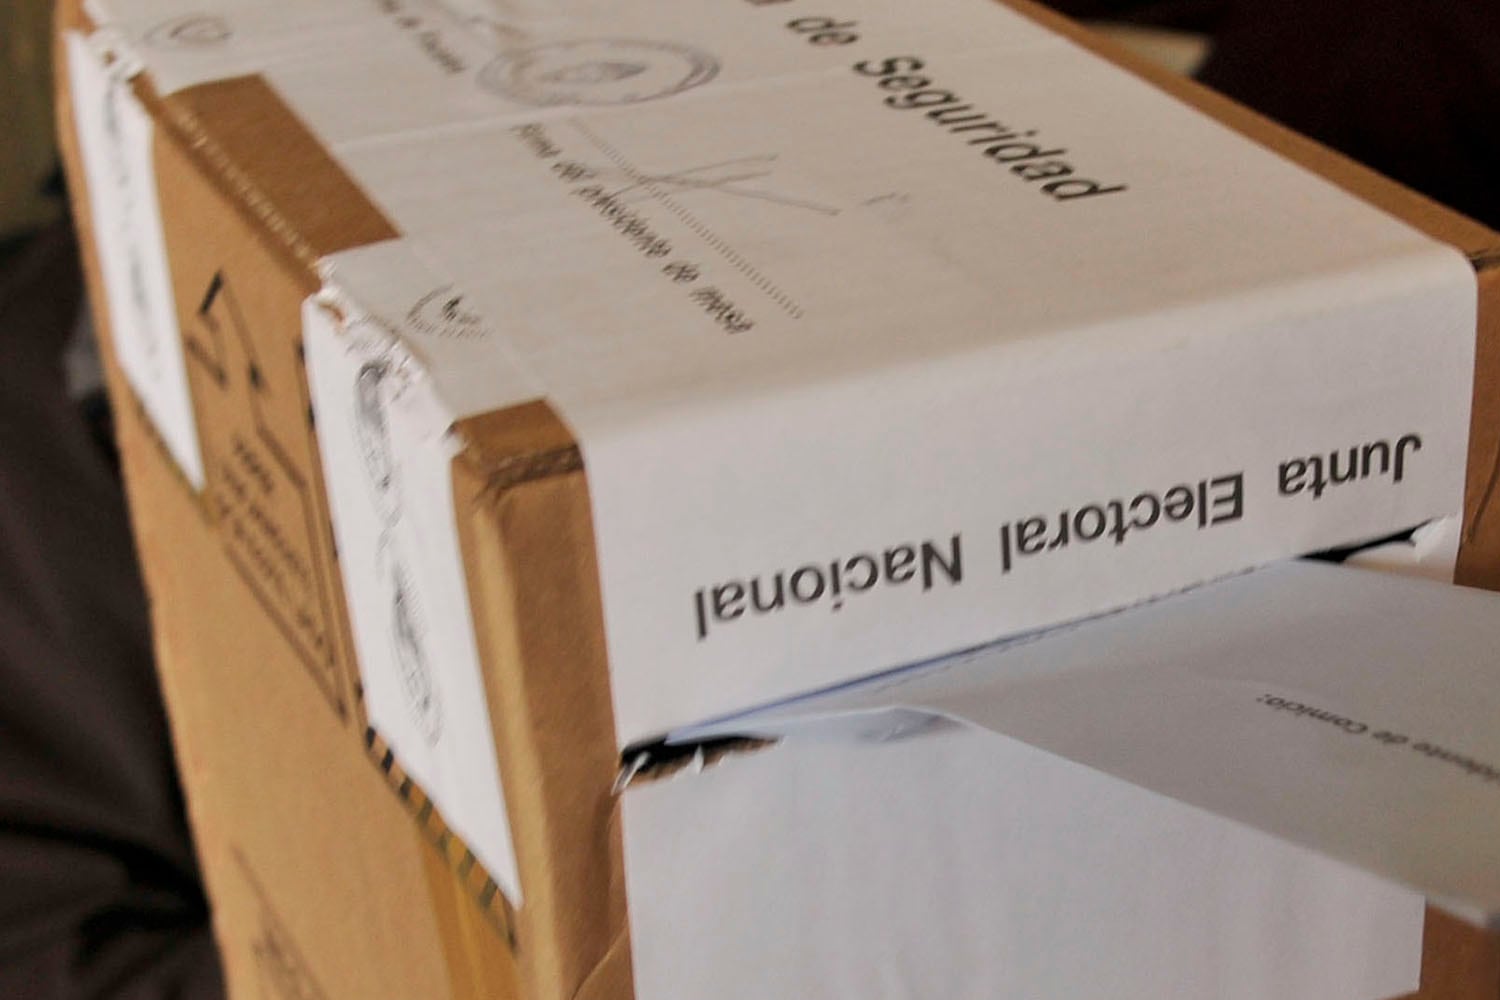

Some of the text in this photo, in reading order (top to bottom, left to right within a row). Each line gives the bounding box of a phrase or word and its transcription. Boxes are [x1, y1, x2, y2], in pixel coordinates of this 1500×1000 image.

[785, 16, 1130, 202] de Seguridad
[691, 432, 1424, 641] Junta Electoral Nacional
[1257, 694, 1369, 735] Comicio:
